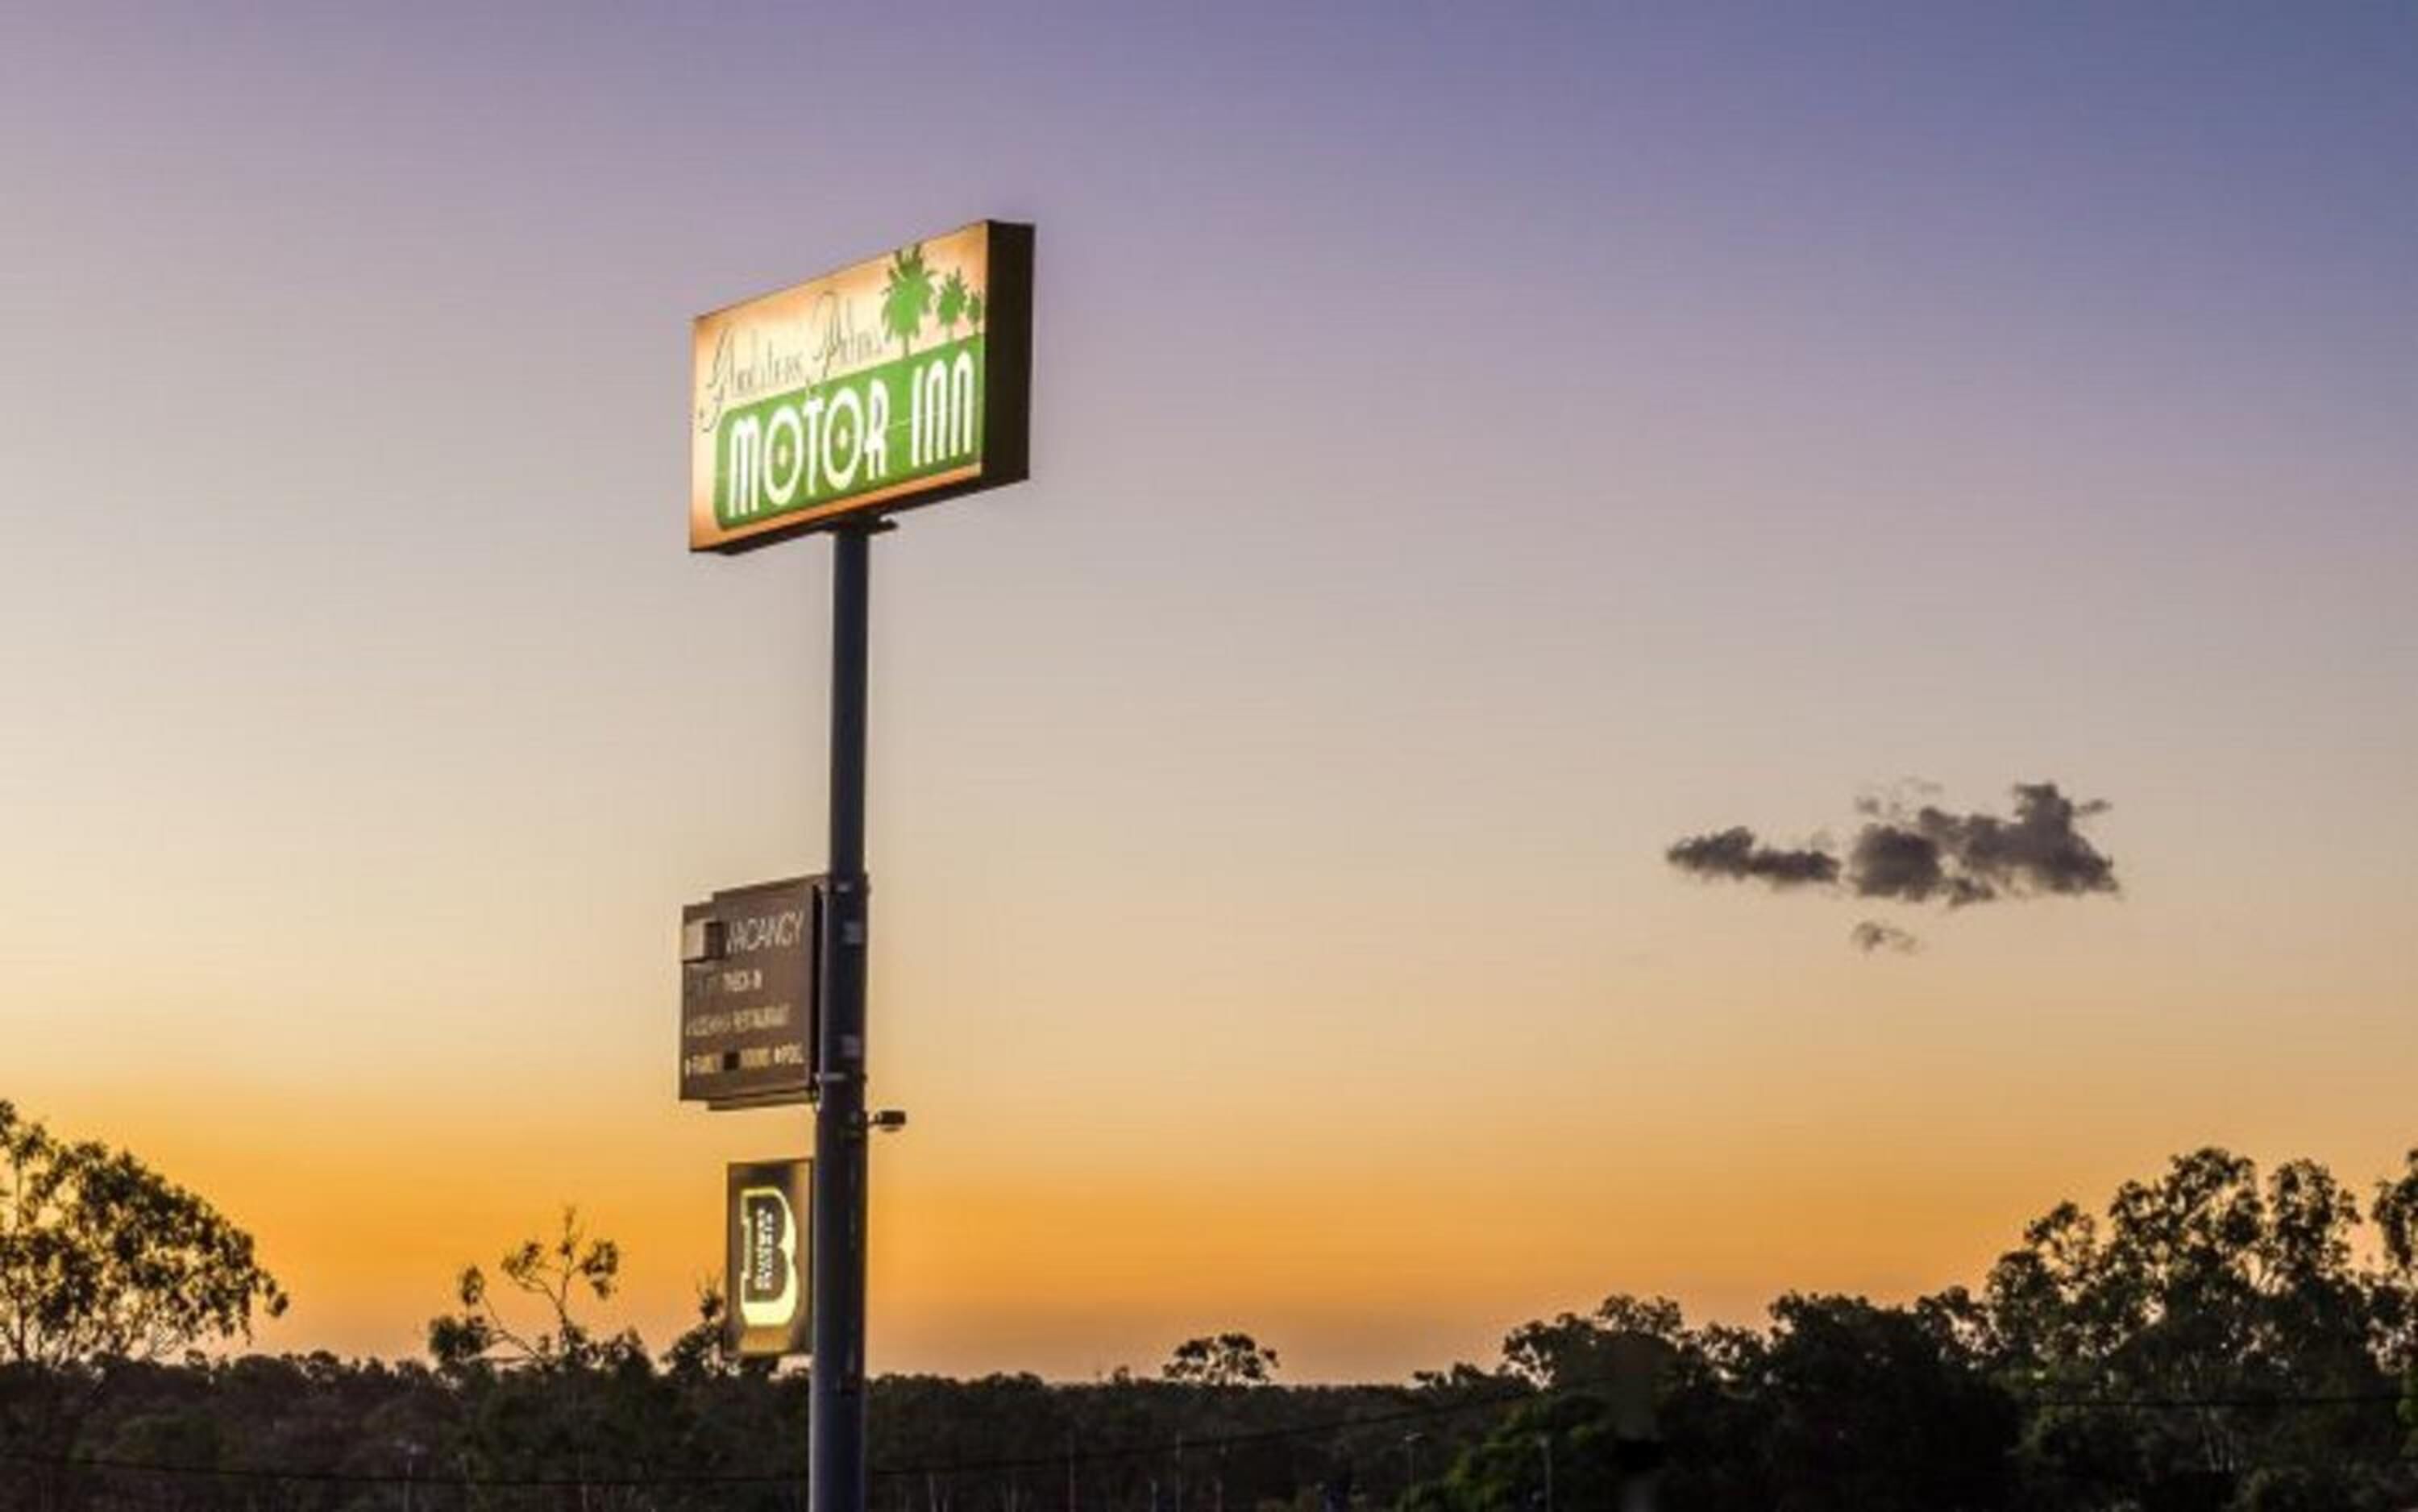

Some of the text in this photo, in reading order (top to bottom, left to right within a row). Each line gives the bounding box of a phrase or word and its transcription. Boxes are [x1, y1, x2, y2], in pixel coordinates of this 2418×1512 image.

[728, 351, 974, 517] MOTOR INN
[726, 912, 803, 953] VACANCY
